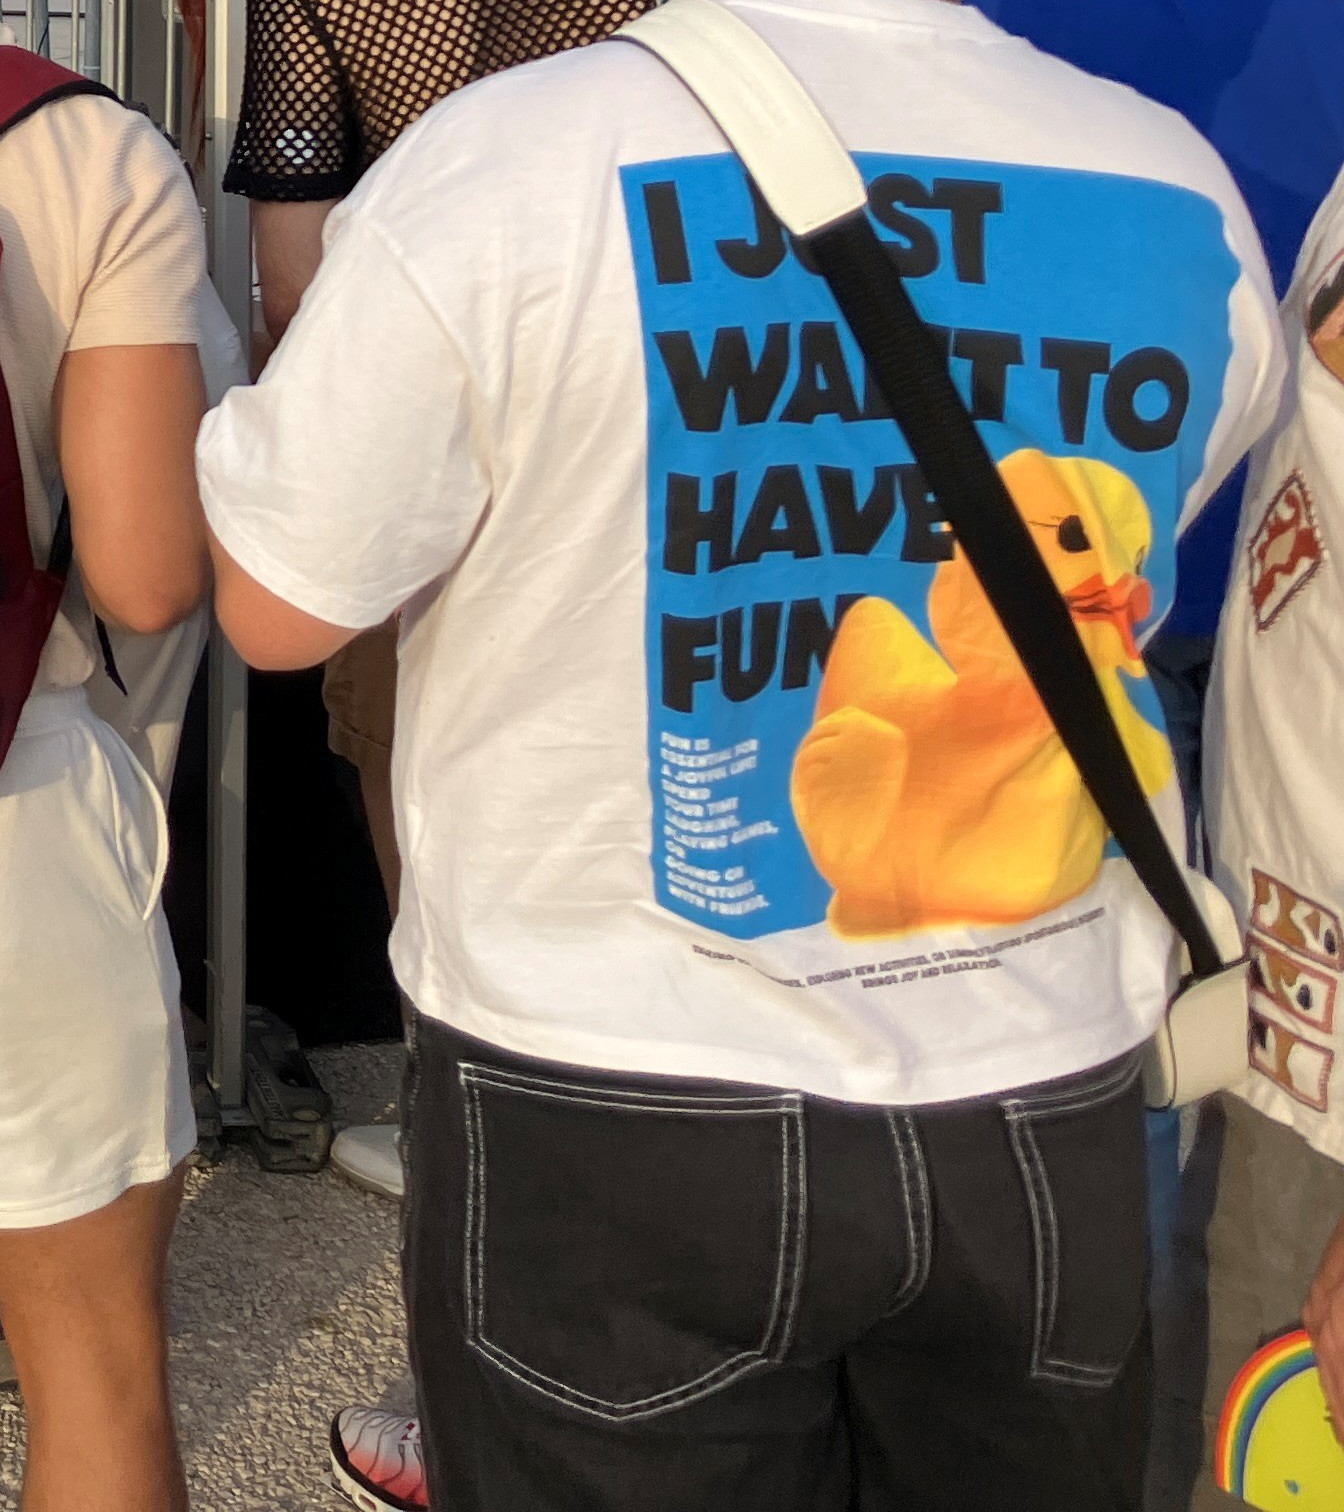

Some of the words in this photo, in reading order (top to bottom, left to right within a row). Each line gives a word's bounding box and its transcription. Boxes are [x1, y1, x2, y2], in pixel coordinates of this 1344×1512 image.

[642, 180, 692, 286] I
[715, 173, 1004, 286] JST
[1040, 337, 1191, 453] TO
[662, 464, 957, 576] HAVE
